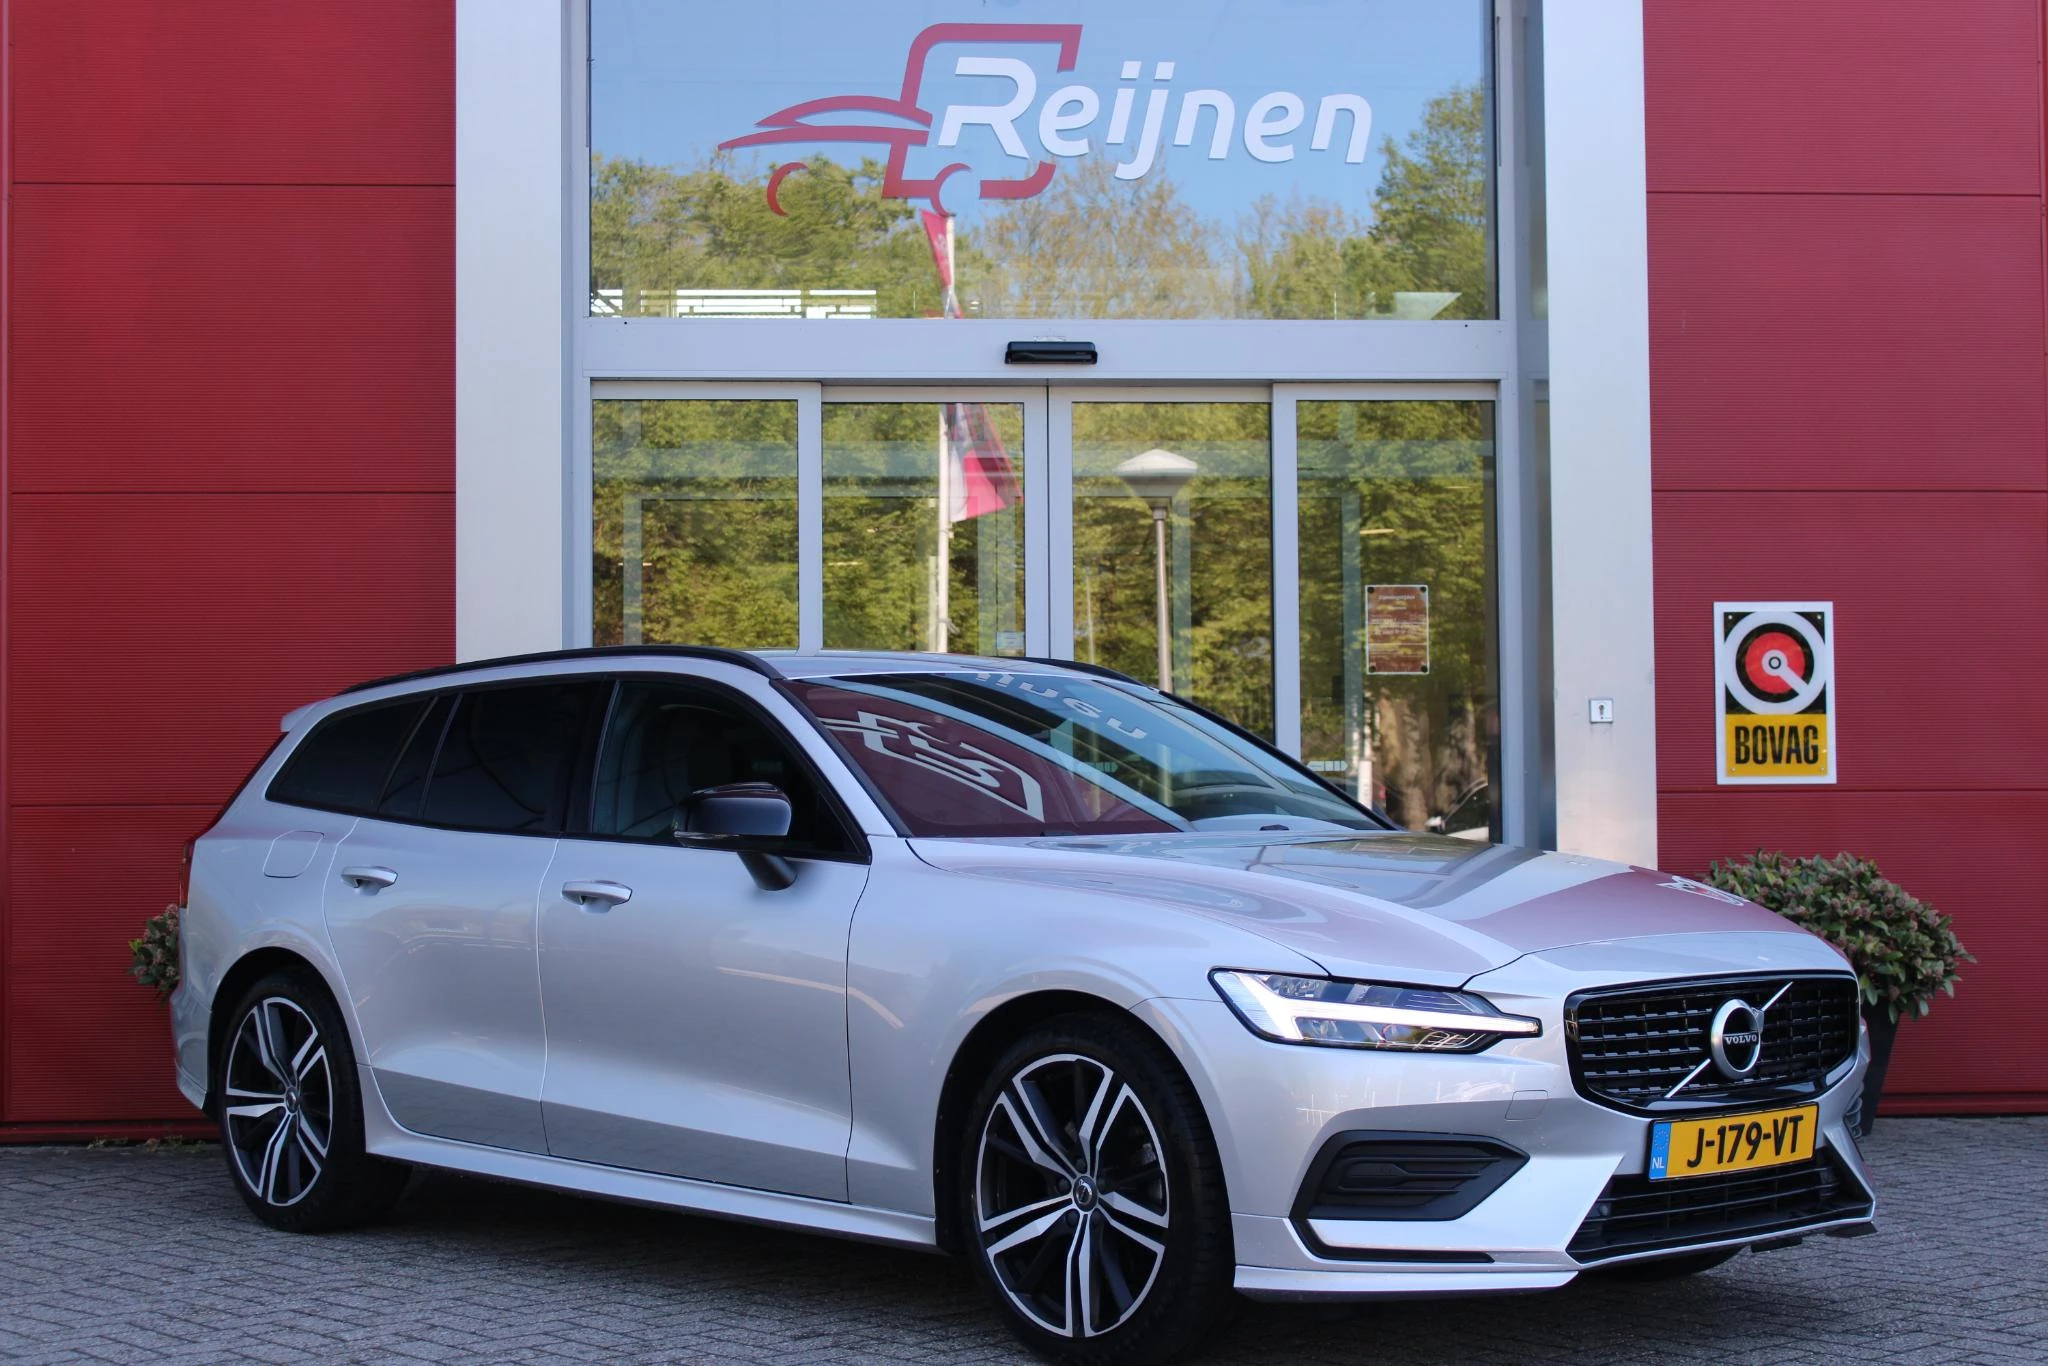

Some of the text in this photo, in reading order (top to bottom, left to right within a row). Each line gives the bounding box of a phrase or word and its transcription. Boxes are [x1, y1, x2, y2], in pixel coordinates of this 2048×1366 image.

[939, 57, 1372, 180] Reijnen
[1735, 726, 1818, 764] BOVAG
[1725, 1034, 1757, 1045] VOLVO
[1687, 1115, 1803, 1168] J-179-VT
[1652, 1157, 1665, 1169] NL
